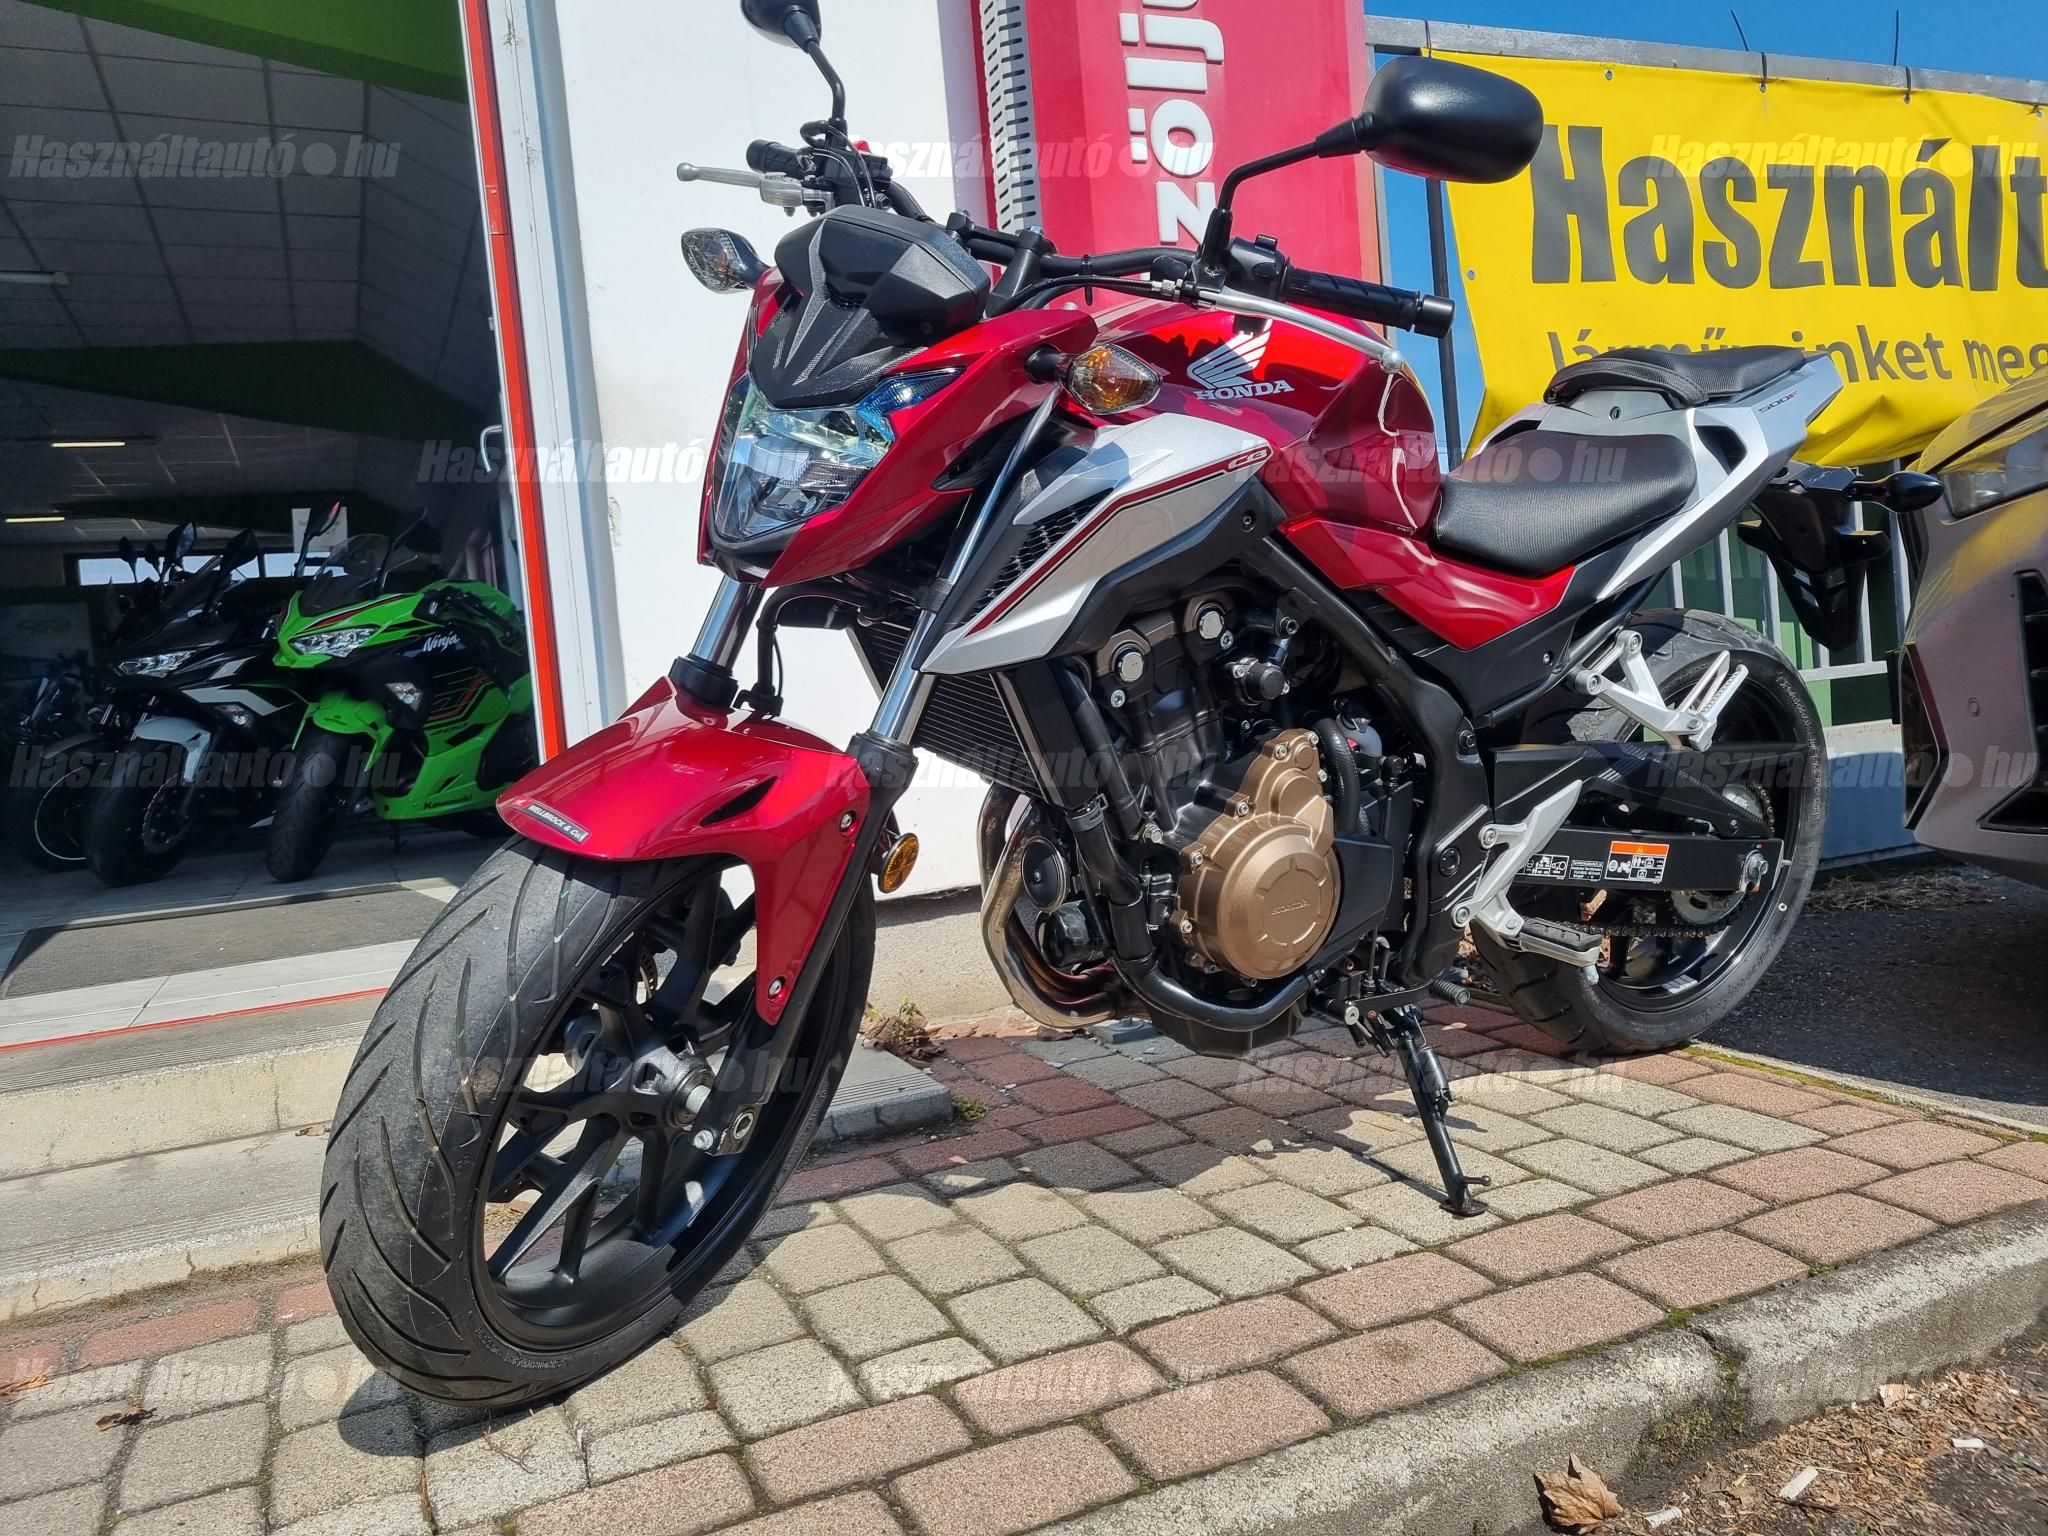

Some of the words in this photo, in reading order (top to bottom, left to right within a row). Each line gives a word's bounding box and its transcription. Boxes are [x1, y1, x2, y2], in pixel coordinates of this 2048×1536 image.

[1194, 380, 1294, 400] HONDA
[423, 630, 461, 652] Ninja
[528, 805, 565, 828] WELLBROCK
